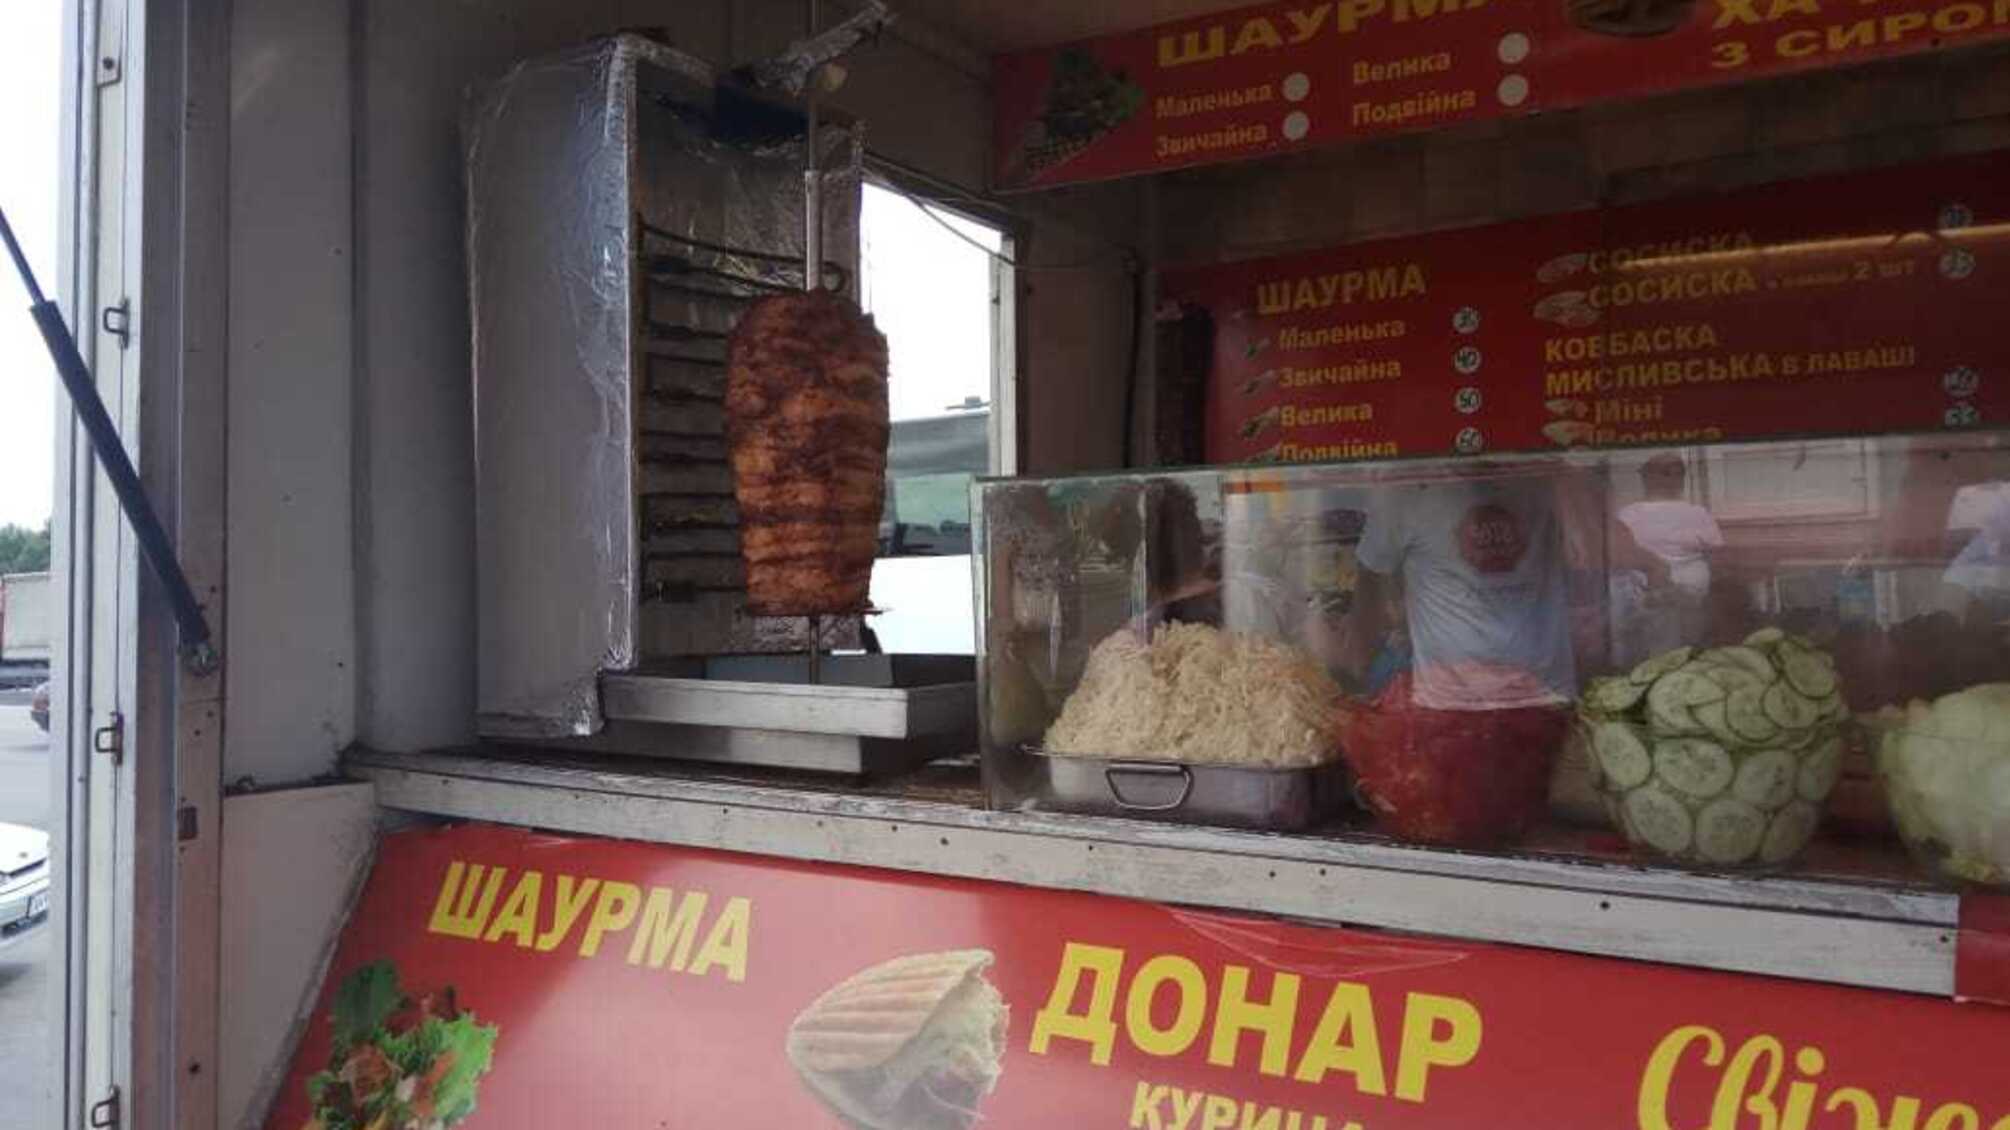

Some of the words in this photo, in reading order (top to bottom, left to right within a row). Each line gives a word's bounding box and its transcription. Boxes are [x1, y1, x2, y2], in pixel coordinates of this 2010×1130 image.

[1157, 0, 1490, 67] ШАУРМ
[1353, 52, 1452, 86] Велика
[1156, 83, 1273, 120] Маленька
[1353, 87, 1478, 128] Подвійна
[1156, 121, 1269, 158] Звичайна
[1257, 262, 1427, 317] ШАУРМА
[1589, 266, 1759, 308] СОСИСКА
[1279, 319, 1406, 352] Маленька
[1544, 322, 1718, 362] КОВБАСКА
[1279, 358, 1402, 388] Звичайна
[1545, 356, 1774, 397] МИСЛИВСЬКА
[1280, 402, 1374, 427] Велика
[1594, 396, 1663, 424] Міні
[427, 860, 754, 983] ШАУРМА
[1029, 942, 1483, 1103] ДОНАР
[1129, 1081, 1367, 1130] КУРИ
